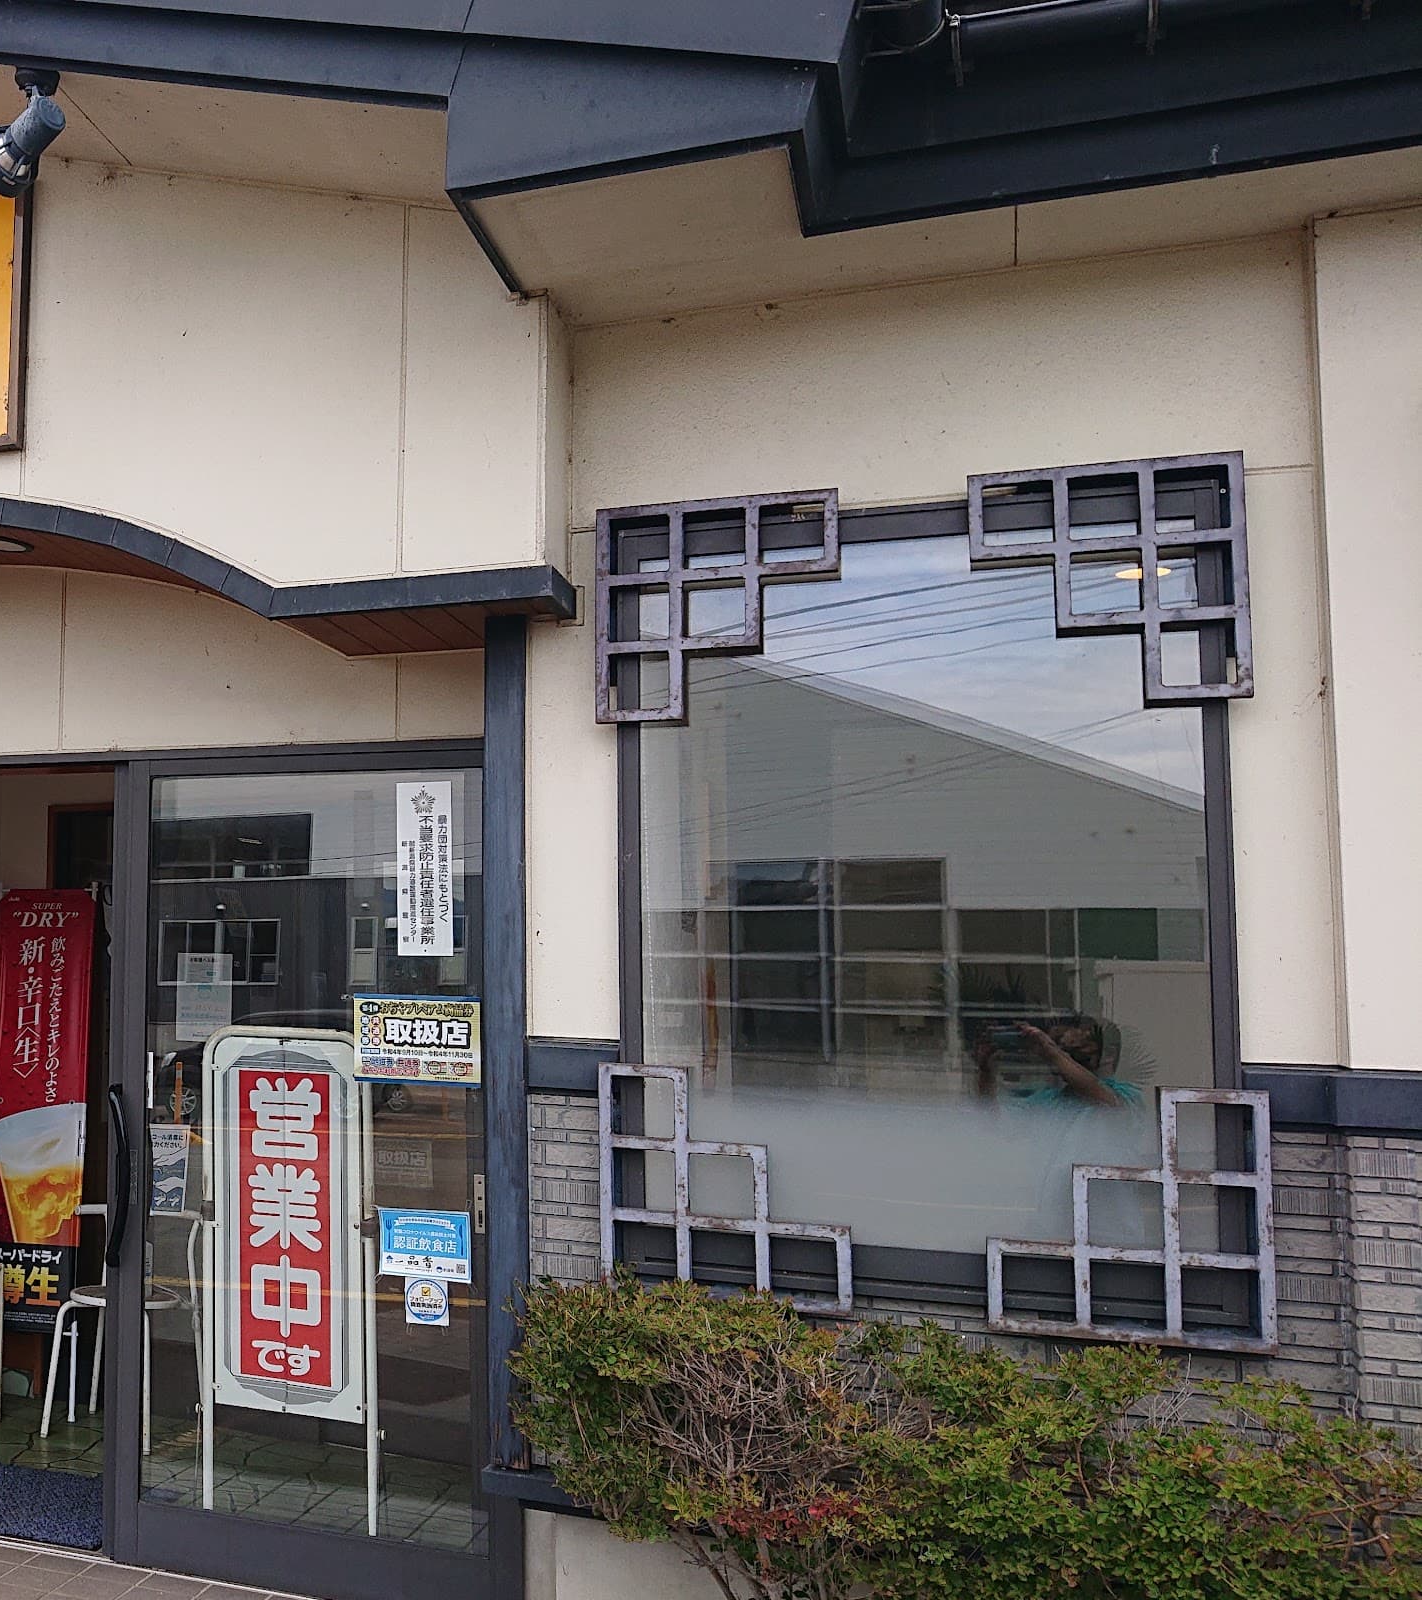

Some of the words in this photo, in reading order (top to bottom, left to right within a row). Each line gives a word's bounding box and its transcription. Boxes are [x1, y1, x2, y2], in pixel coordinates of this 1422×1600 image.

[31, 902, 62, 911] SUPER
[44, 937, 66, 1103] 飲みごたえとキレのよさ
[384, 1018, 470, 1048] 取扱店
[393, 1236, 458, 1254] 認証飲食店
